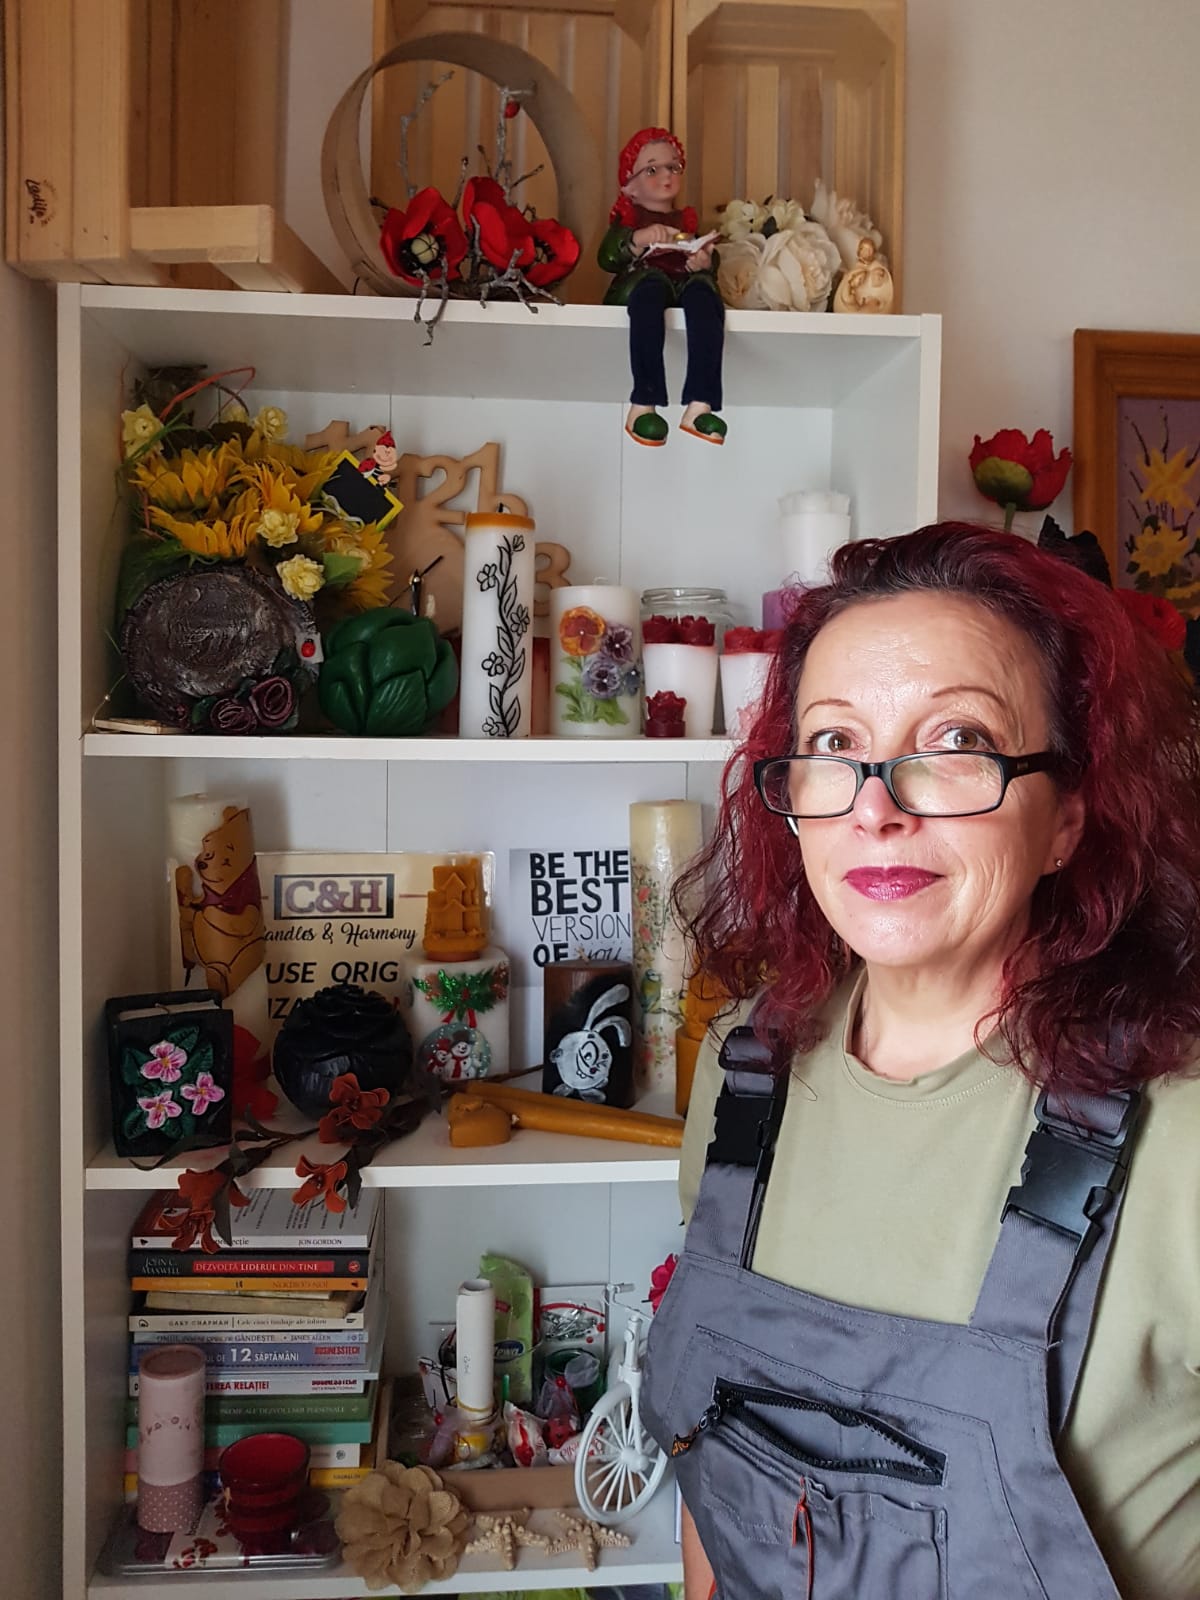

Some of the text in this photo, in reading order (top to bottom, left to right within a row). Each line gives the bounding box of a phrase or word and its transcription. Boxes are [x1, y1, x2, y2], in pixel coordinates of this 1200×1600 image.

[530, 850, 629, 879] BE THE
[284, 879, 383, 914] C&H
[531, 877, 629, 916] BEST
[264, 921, 417, 949] andles & Harmony
[532, 913, 631, 942] VERSION
[533, 943, 569, 968] OF
[231, 1347, 253, 1362] 12
